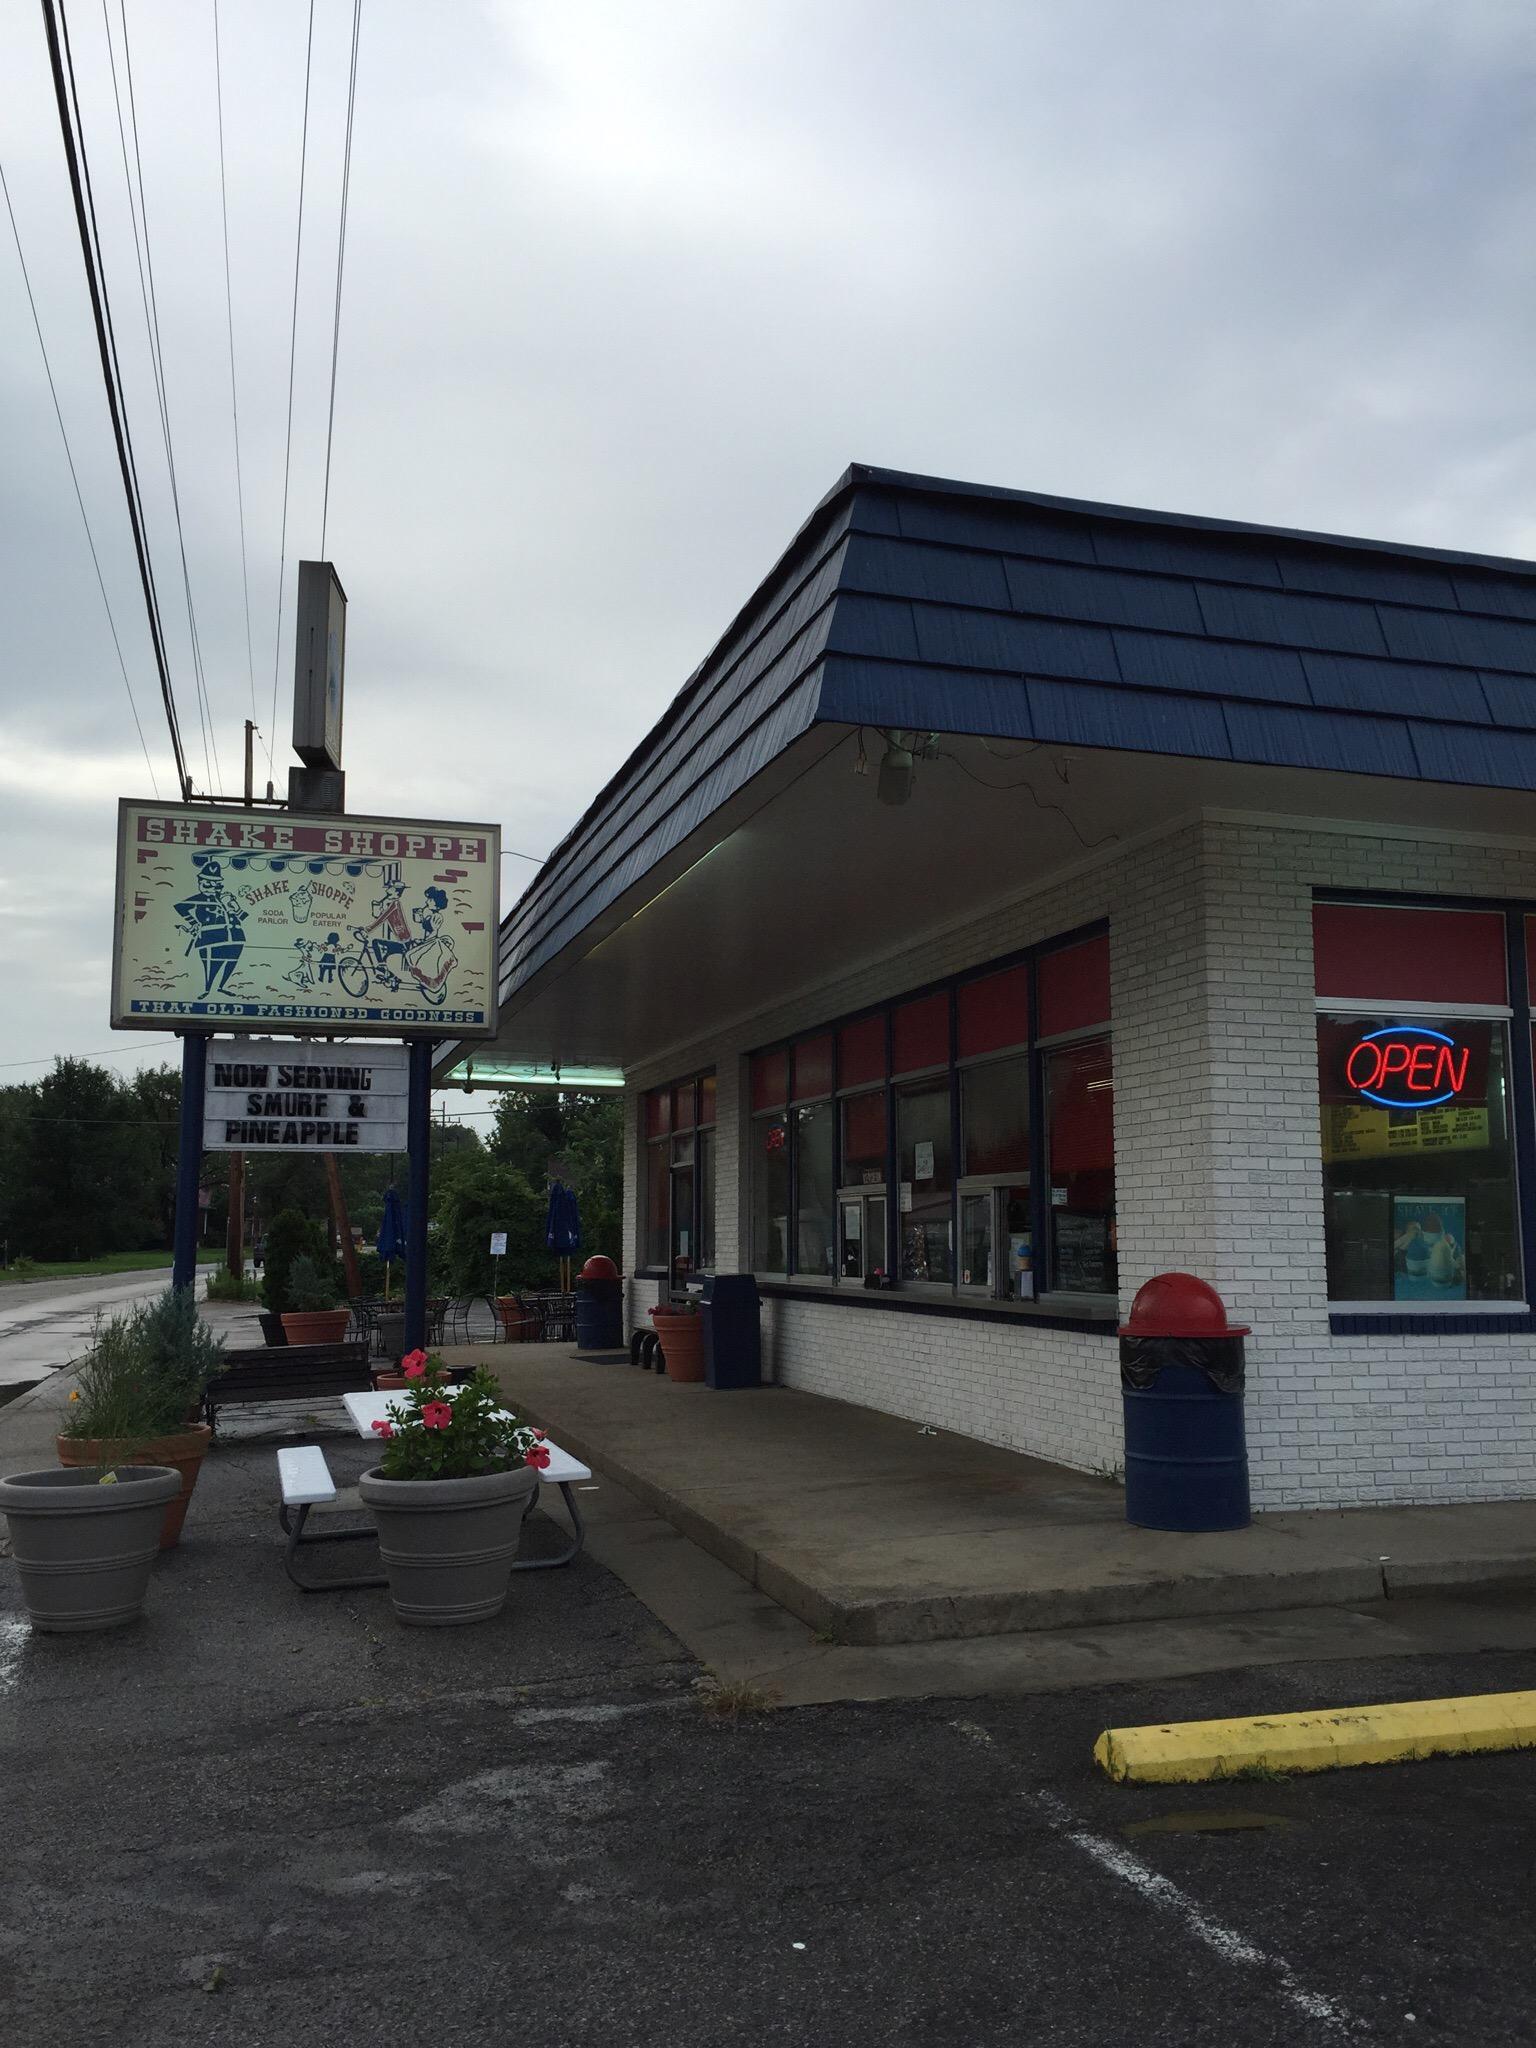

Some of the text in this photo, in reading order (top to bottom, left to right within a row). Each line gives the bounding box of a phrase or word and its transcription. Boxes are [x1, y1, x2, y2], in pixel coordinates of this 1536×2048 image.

[145, 818, 479, 862] SHAKE SHOPPE
[245, 880, 354, 910] SHAKE SHOPPE
[257, 917, 289, 925] PARLOR
[262, 909, 284, 917] SODA
[310, 911, 347, 920] POPULAR
[312, 919, 342, 928] EATERY
[138, 1001, 475, 1022] THAT OLD FASHIONED GOODNESS
[214, 1063, 373, 1091] NOW SERVING
[1347, 1042, 1469, 1091] OPEN
[246, 1092, 367, 1118] SMURF &
[225, 1119, 360, 1145] PINEAPPLE
